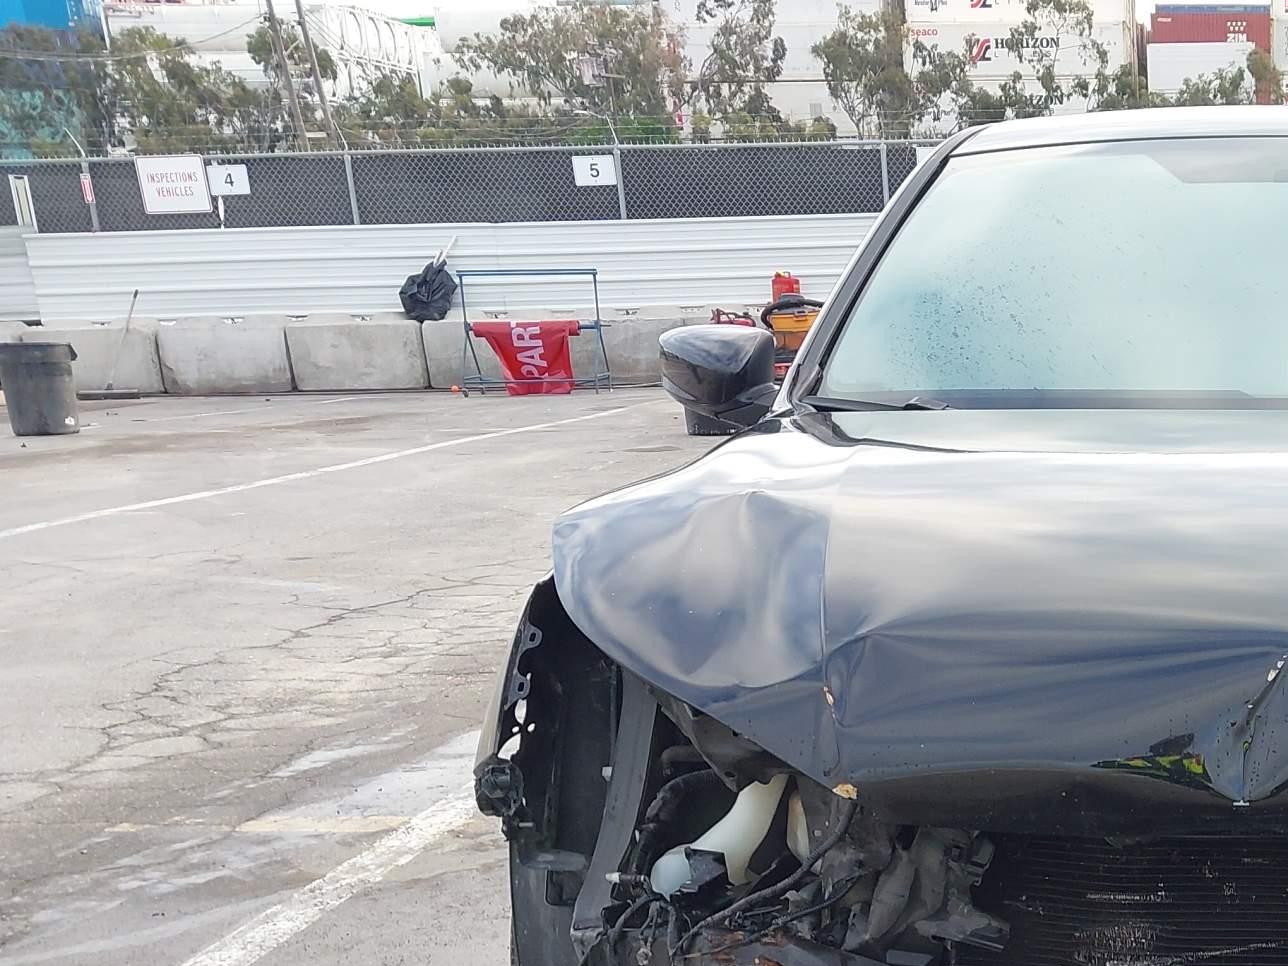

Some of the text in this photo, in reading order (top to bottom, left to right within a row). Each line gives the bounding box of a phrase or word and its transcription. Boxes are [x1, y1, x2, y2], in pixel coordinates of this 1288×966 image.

[911, 28, 938, 36] seaco
[1226, 33, 1247, 43] ZIM
[146, 171, 199, 183] INSPECTIONS
[589, 163, 600, 178] 5
[224, 173, 235, 187] 4
[155, 185, 194, 198] VEHICLES
[510, 320, 548, 379] PAR
